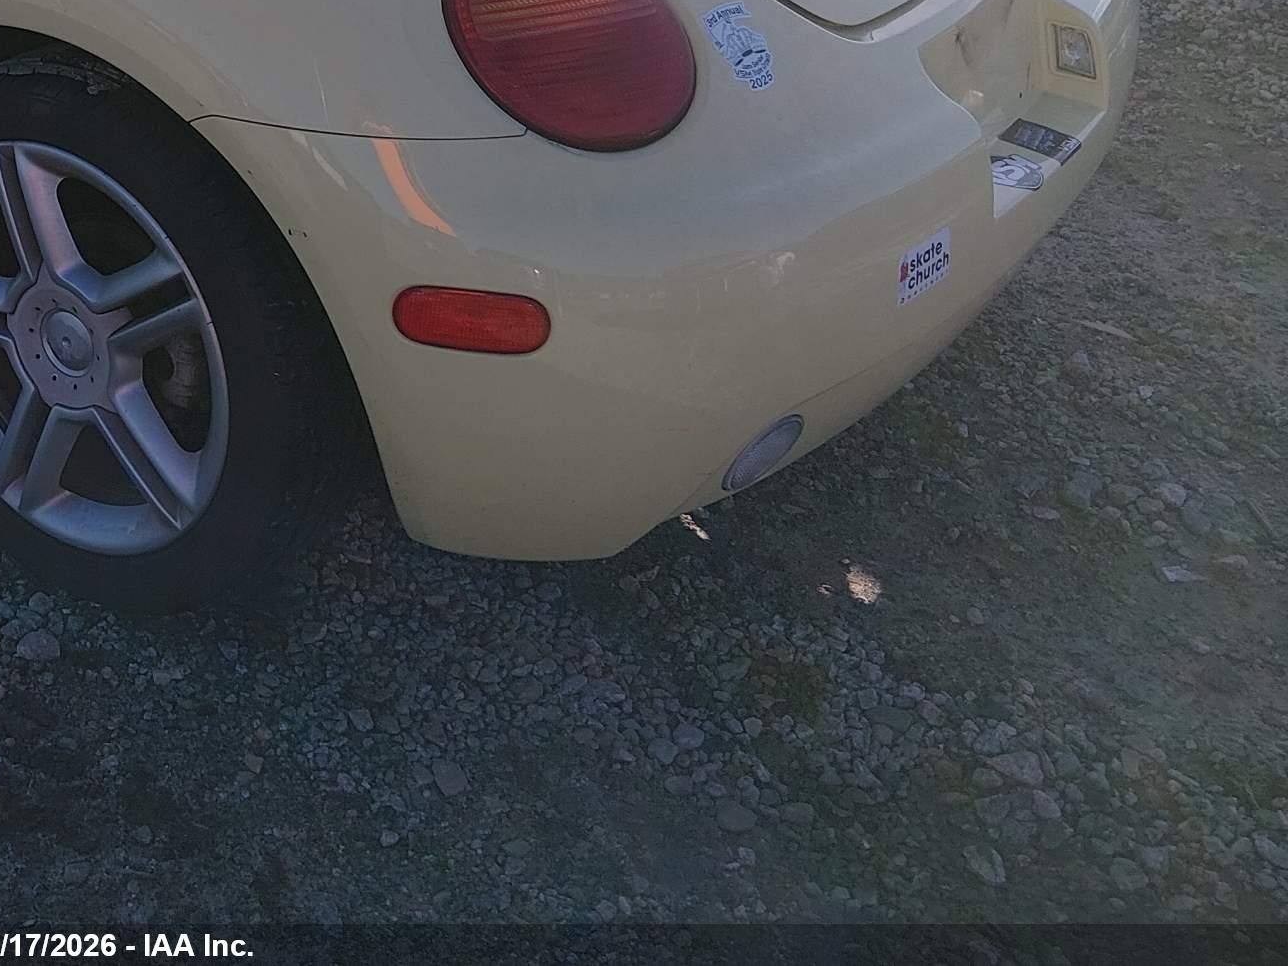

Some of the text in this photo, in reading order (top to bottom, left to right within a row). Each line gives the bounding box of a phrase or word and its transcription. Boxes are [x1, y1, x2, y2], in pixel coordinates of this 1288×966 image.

[750, 71, 773, 89] 2025
[908, 252, 949, 290] church
[910, 241, 943, 273] skate
